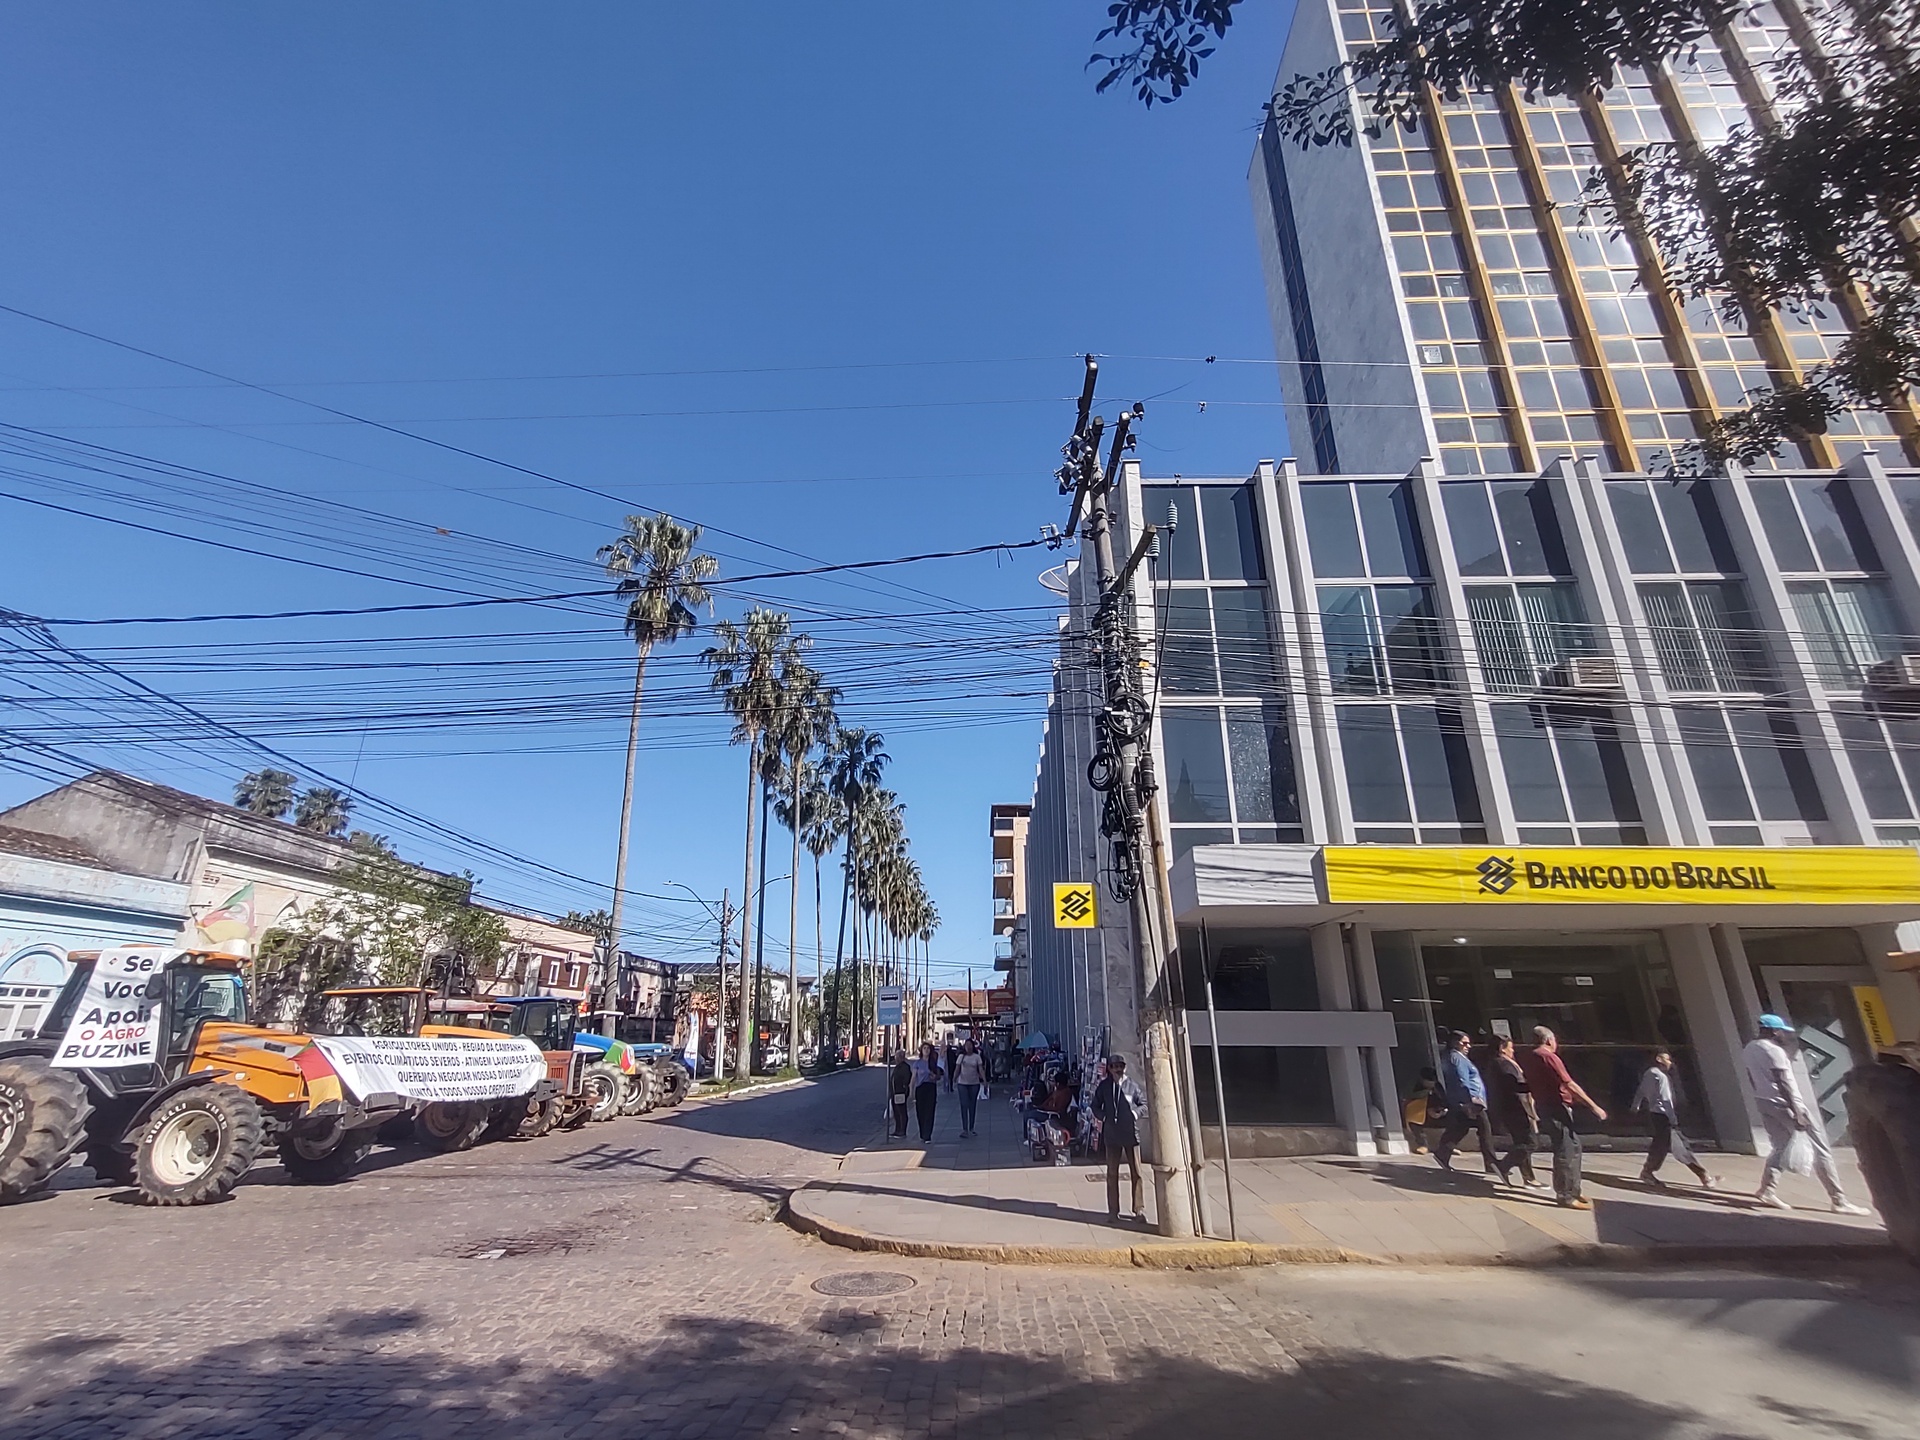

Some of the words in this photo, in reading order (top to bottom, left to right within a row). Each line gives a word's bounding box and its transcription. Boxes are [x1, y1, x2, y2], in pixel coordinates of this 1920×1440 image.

[1524, 861, 1628, 889] BANCO
[1630, 865, 1671, 889] DO
[1671, 861, 1776, 890] BRASIL
[123, 955, 153, 972] Se
[104, 981, 147, 999] Voc
[80, 1029, 95, 1041] O
[99, 1027, 146, 1041] AGRO
[62, 1041, 152, 1059] BUZINE
[372, 1040, 431, 1051] AGRICULTORES
[432, 1042, 458, 1052] UNIDOS
[486, 1042, 495, 1052] DA
[342, 1052, 384, 1065] EVENTOS
[430, 1056, 461, 1067] SEVEROS
[465, 1056, 492, 1067] ATINGEM
[492, 1055, 524, 1066] LAVOURAS
[524, 1055, 530, 1064] E
[397, 1071, 438, 1083] QUEREMOS
[438, 1071, 472, 1082] NEGOCIAR
[472, 1070, 498, 1081] NOSSAS
[439, 1086, 463, 1097] TODOS
[462, 1085, 488, 1096] NOSSOS
[145, 1102, 187, 1144] PIRELLI
